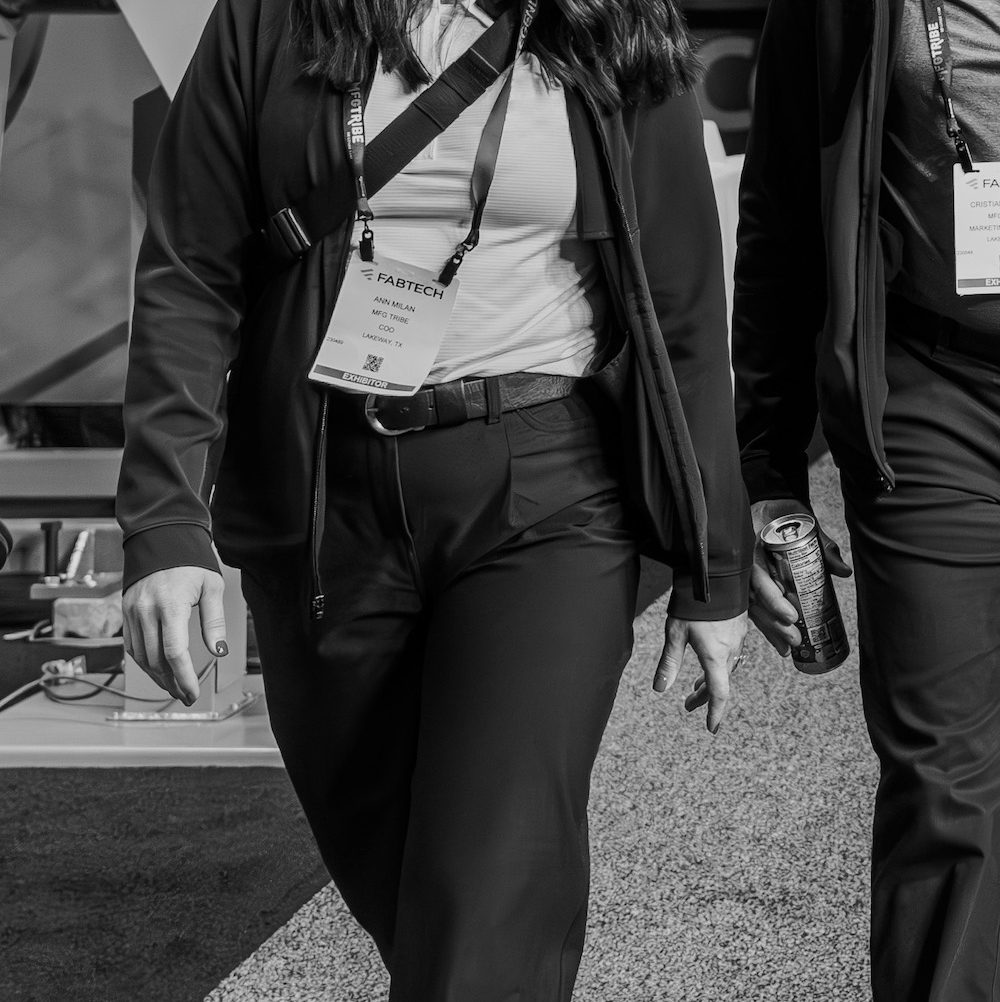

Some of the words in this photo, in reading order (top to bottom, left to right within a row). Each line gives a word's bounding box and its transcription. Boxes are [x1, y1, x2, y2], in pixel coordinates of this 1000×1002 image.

[377, 272, 445, 300] FABTECH
[373, 296, 391, 306] ANN
[391, 300, 416, 313] MILAN
[371, 309, 388, 319] MFG
[389, 313, 410, 325] TRIBE
[378, 324, 395, 334] COO
[394, 340, 403, 348] TX
[341, 372, 389, 389] EXHIBITOR
